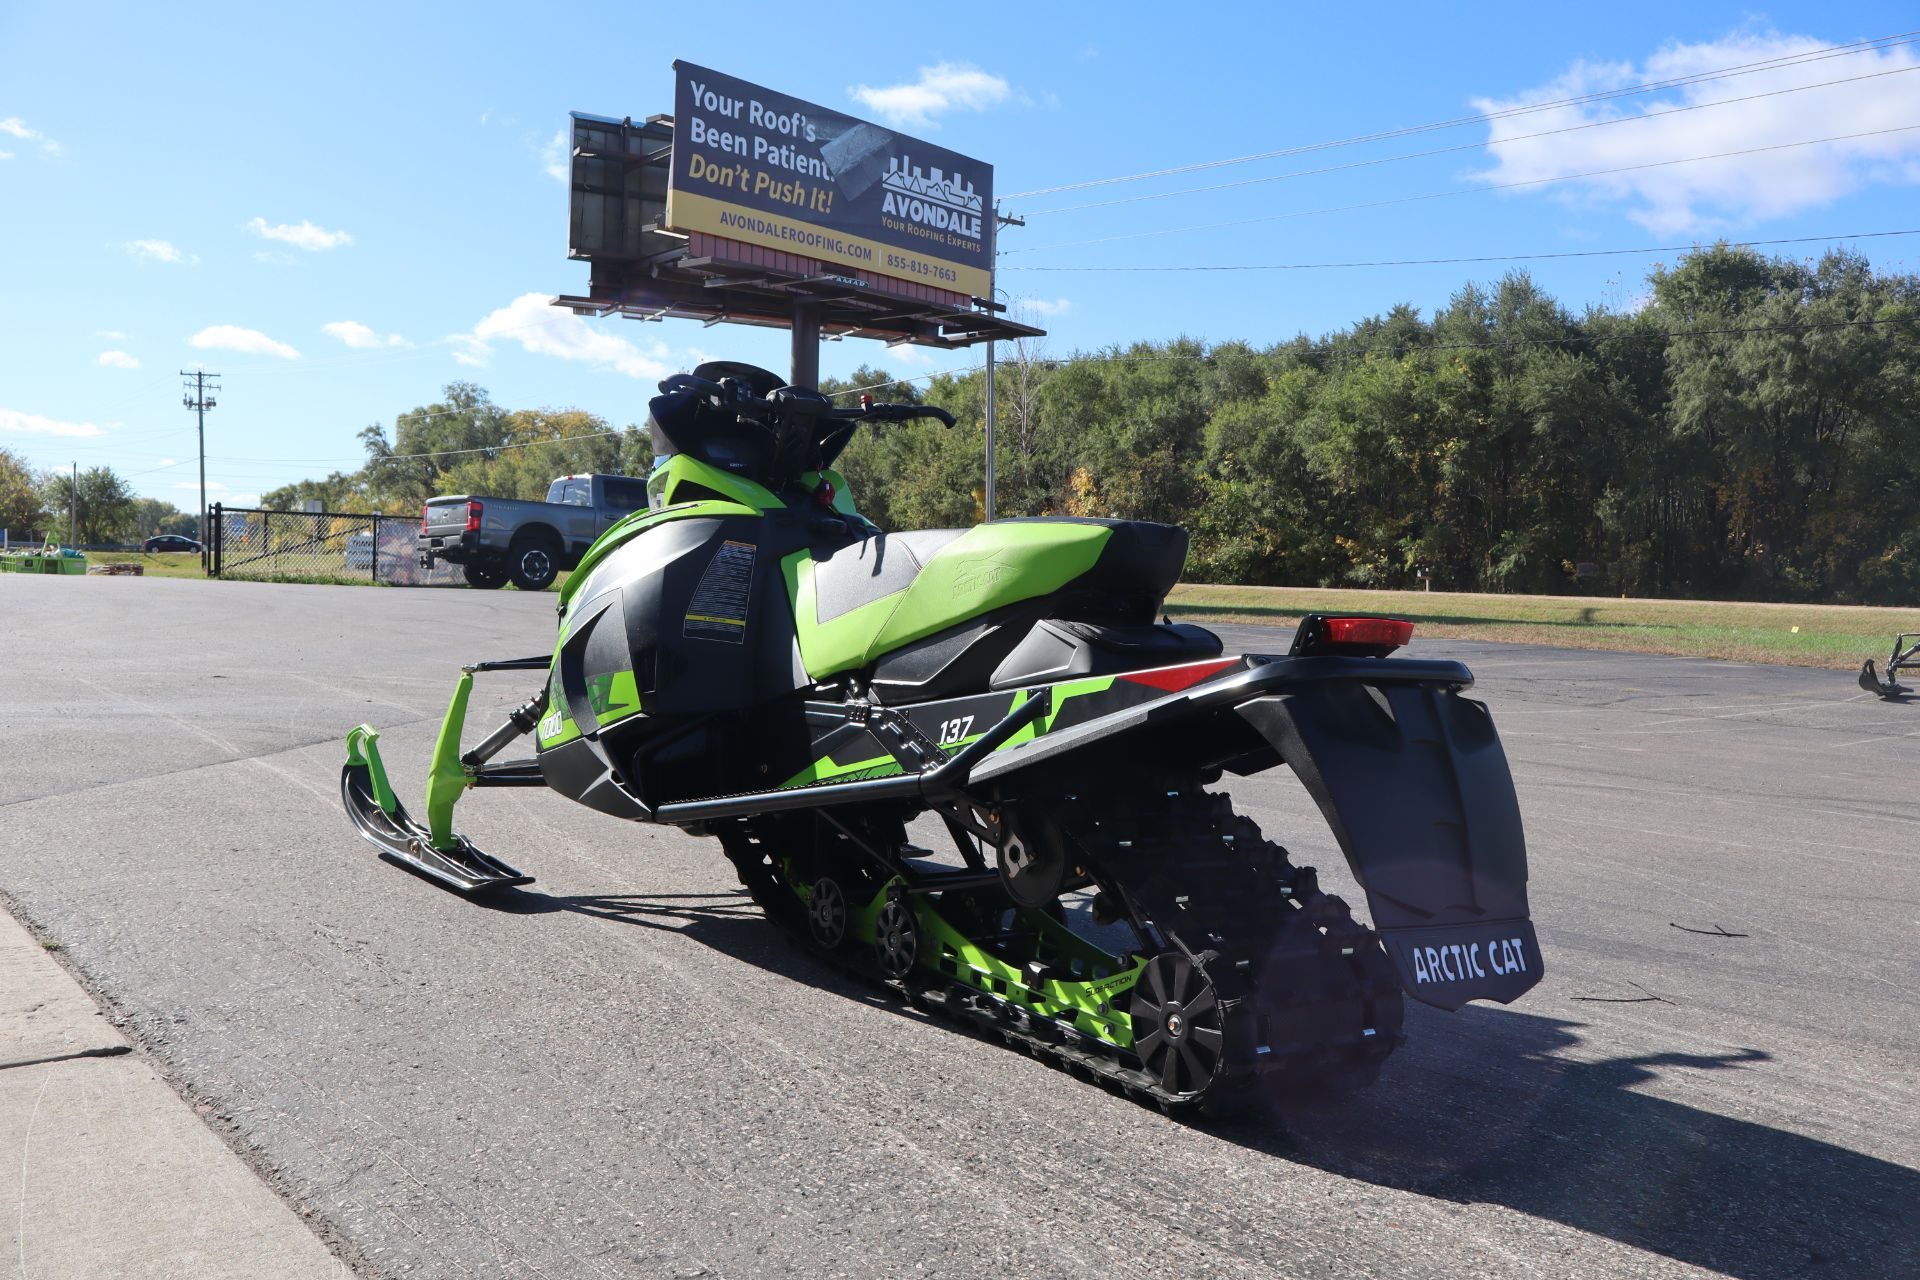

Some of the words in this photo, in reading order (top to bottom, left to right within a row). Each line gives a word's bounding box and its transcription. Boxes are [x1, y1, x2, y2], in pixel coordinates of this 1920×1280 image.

[690, 80, 743, 119] Your
[750, 100, 816, 142] Roof's
[690, 116, 747, 156] Been
[688, 153, 750, 192] Don't
[754, 171, 806, 207] Push
[810, 187, 833, 214] It!
[882, 191, 981, 240] AVONDALE
[720, 211, 872, 262] AVONDALEROOFING.COM
[887, 254, 957, 282] 855-819-7663
[939, 715, 975, 746] 137
[1413, 942, 1486, 984] ARCTIC
[1488, 938, 1527, 976] CAT
